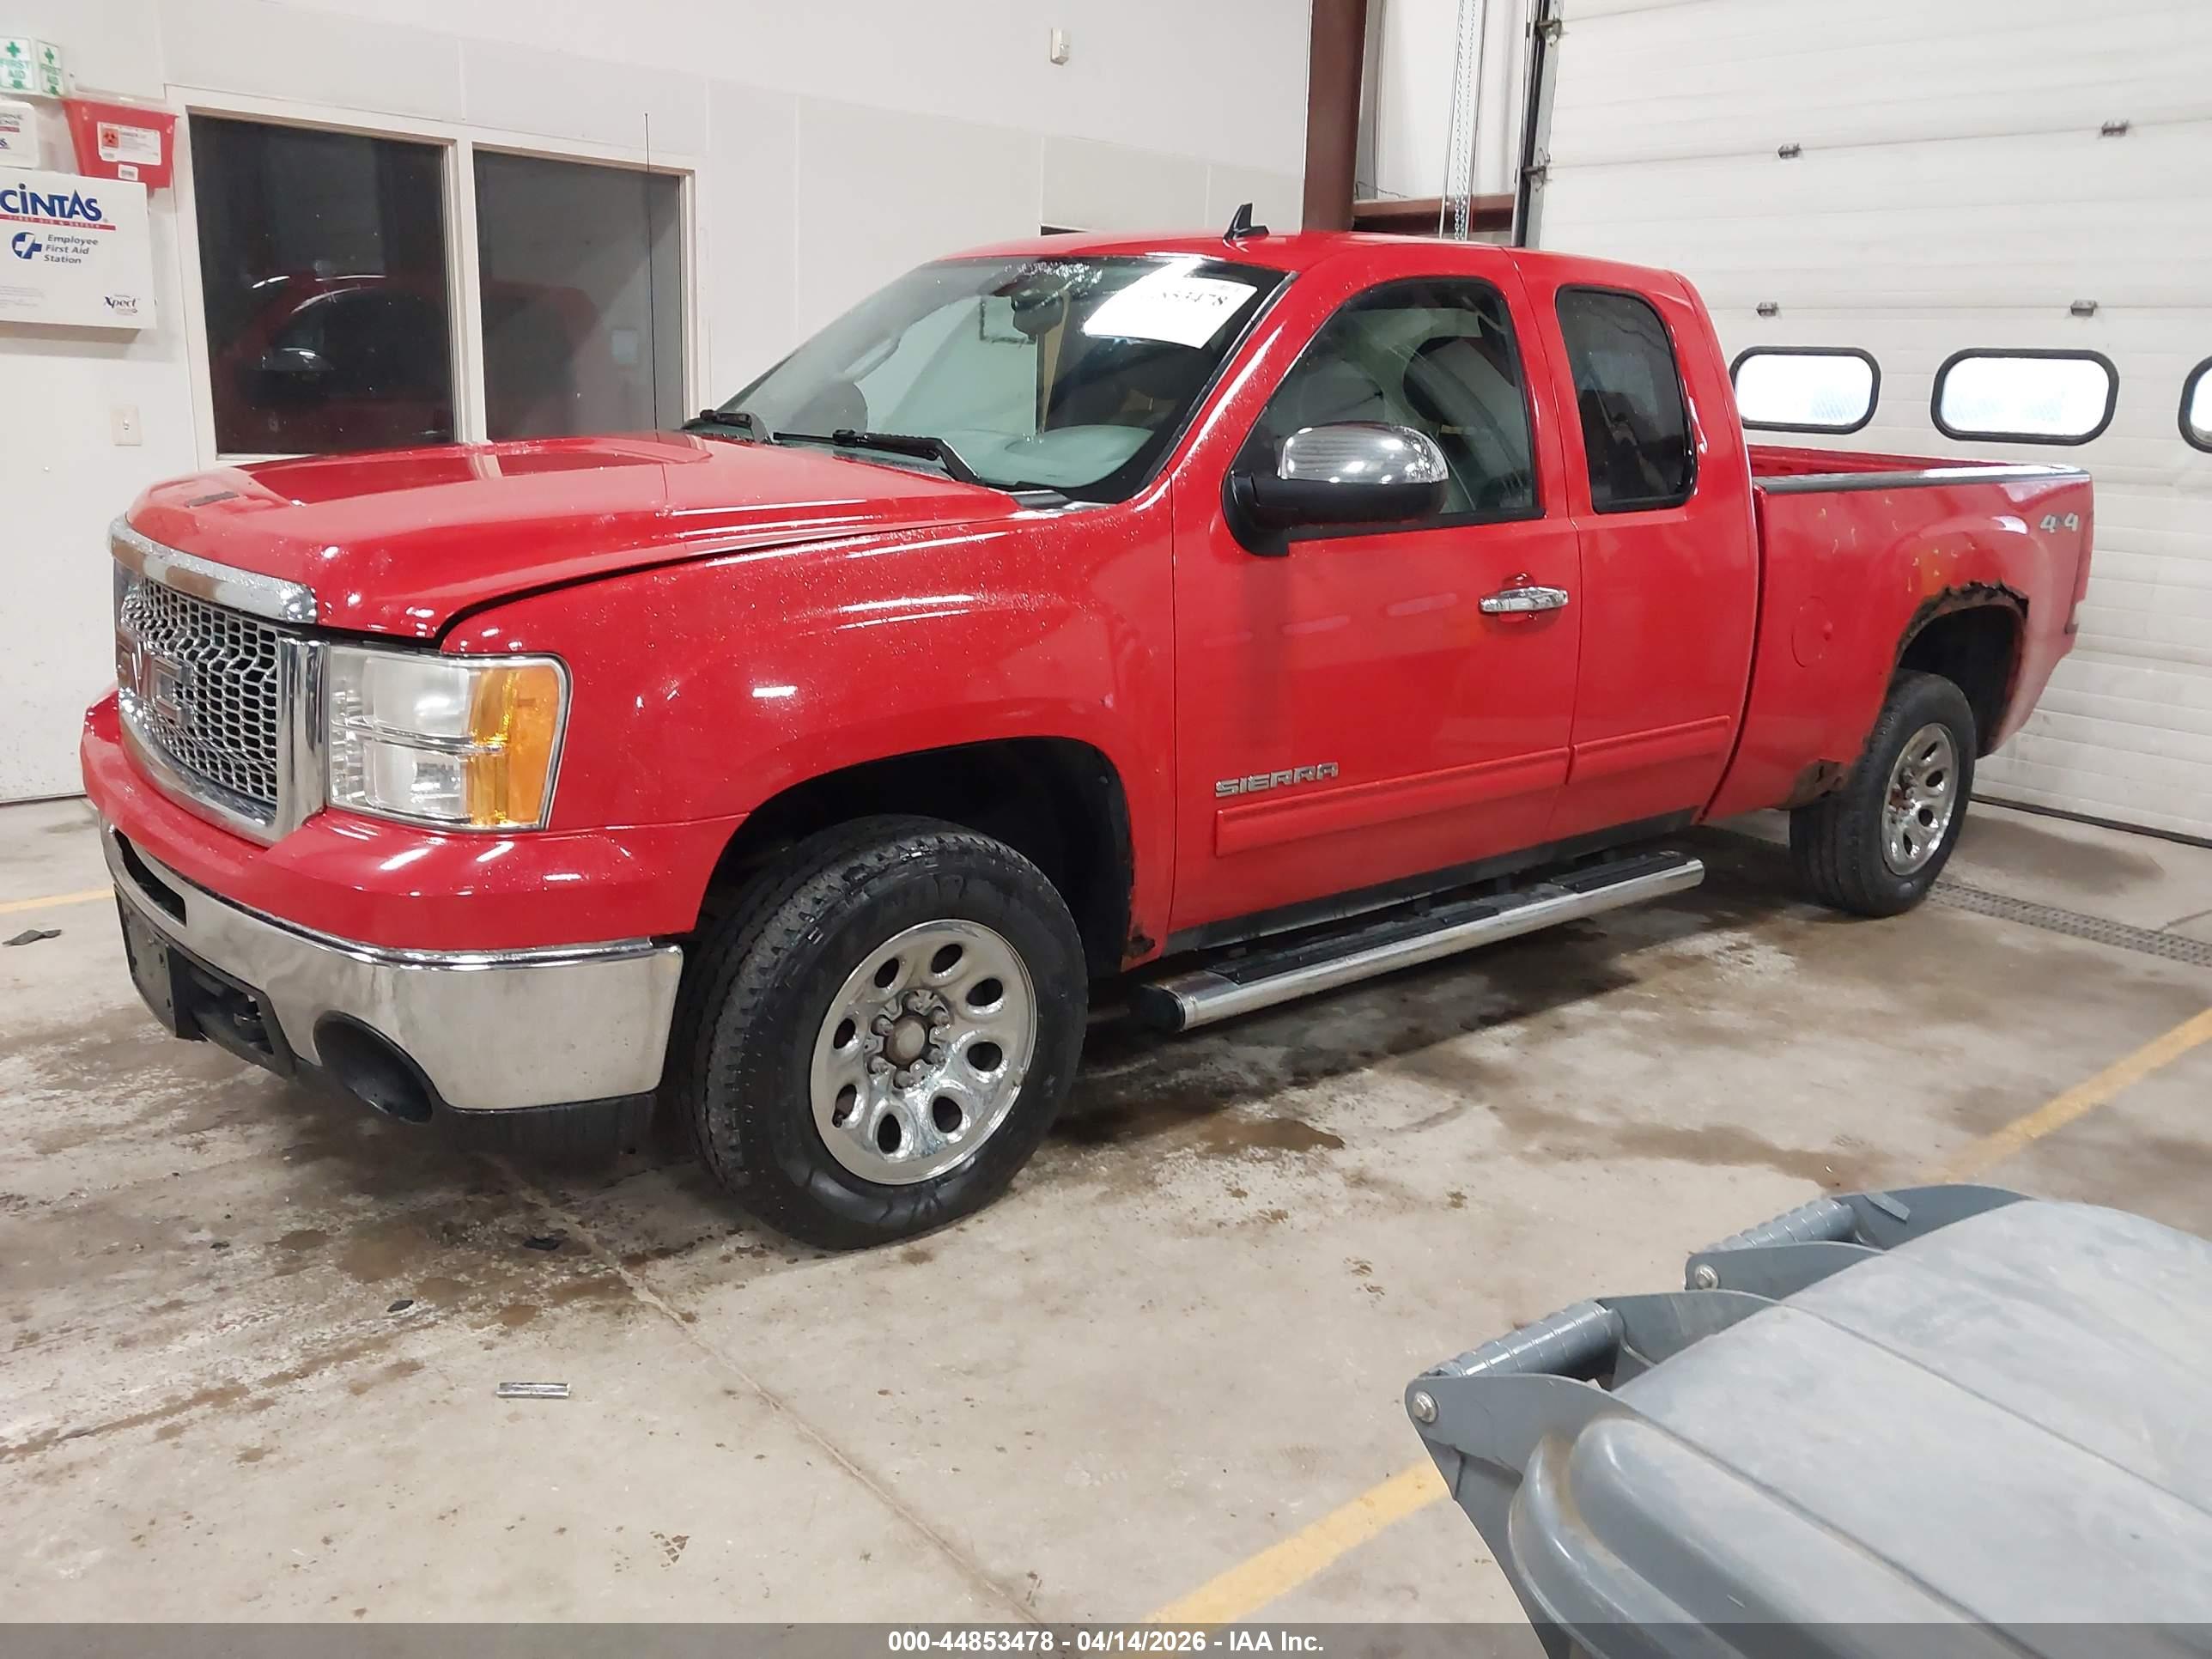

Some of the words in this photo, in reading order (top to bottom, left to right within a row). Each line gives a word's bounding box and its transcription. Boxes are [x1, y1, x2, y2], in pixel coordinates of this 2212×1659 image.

[48, 234, 99, 246] Employee
[46, 245, 69, 253] First
[44, 254, 82, 264] Station
[2039, 513, 2079, 533] 44
[1215, 763, 1339, 798] SIERRA
